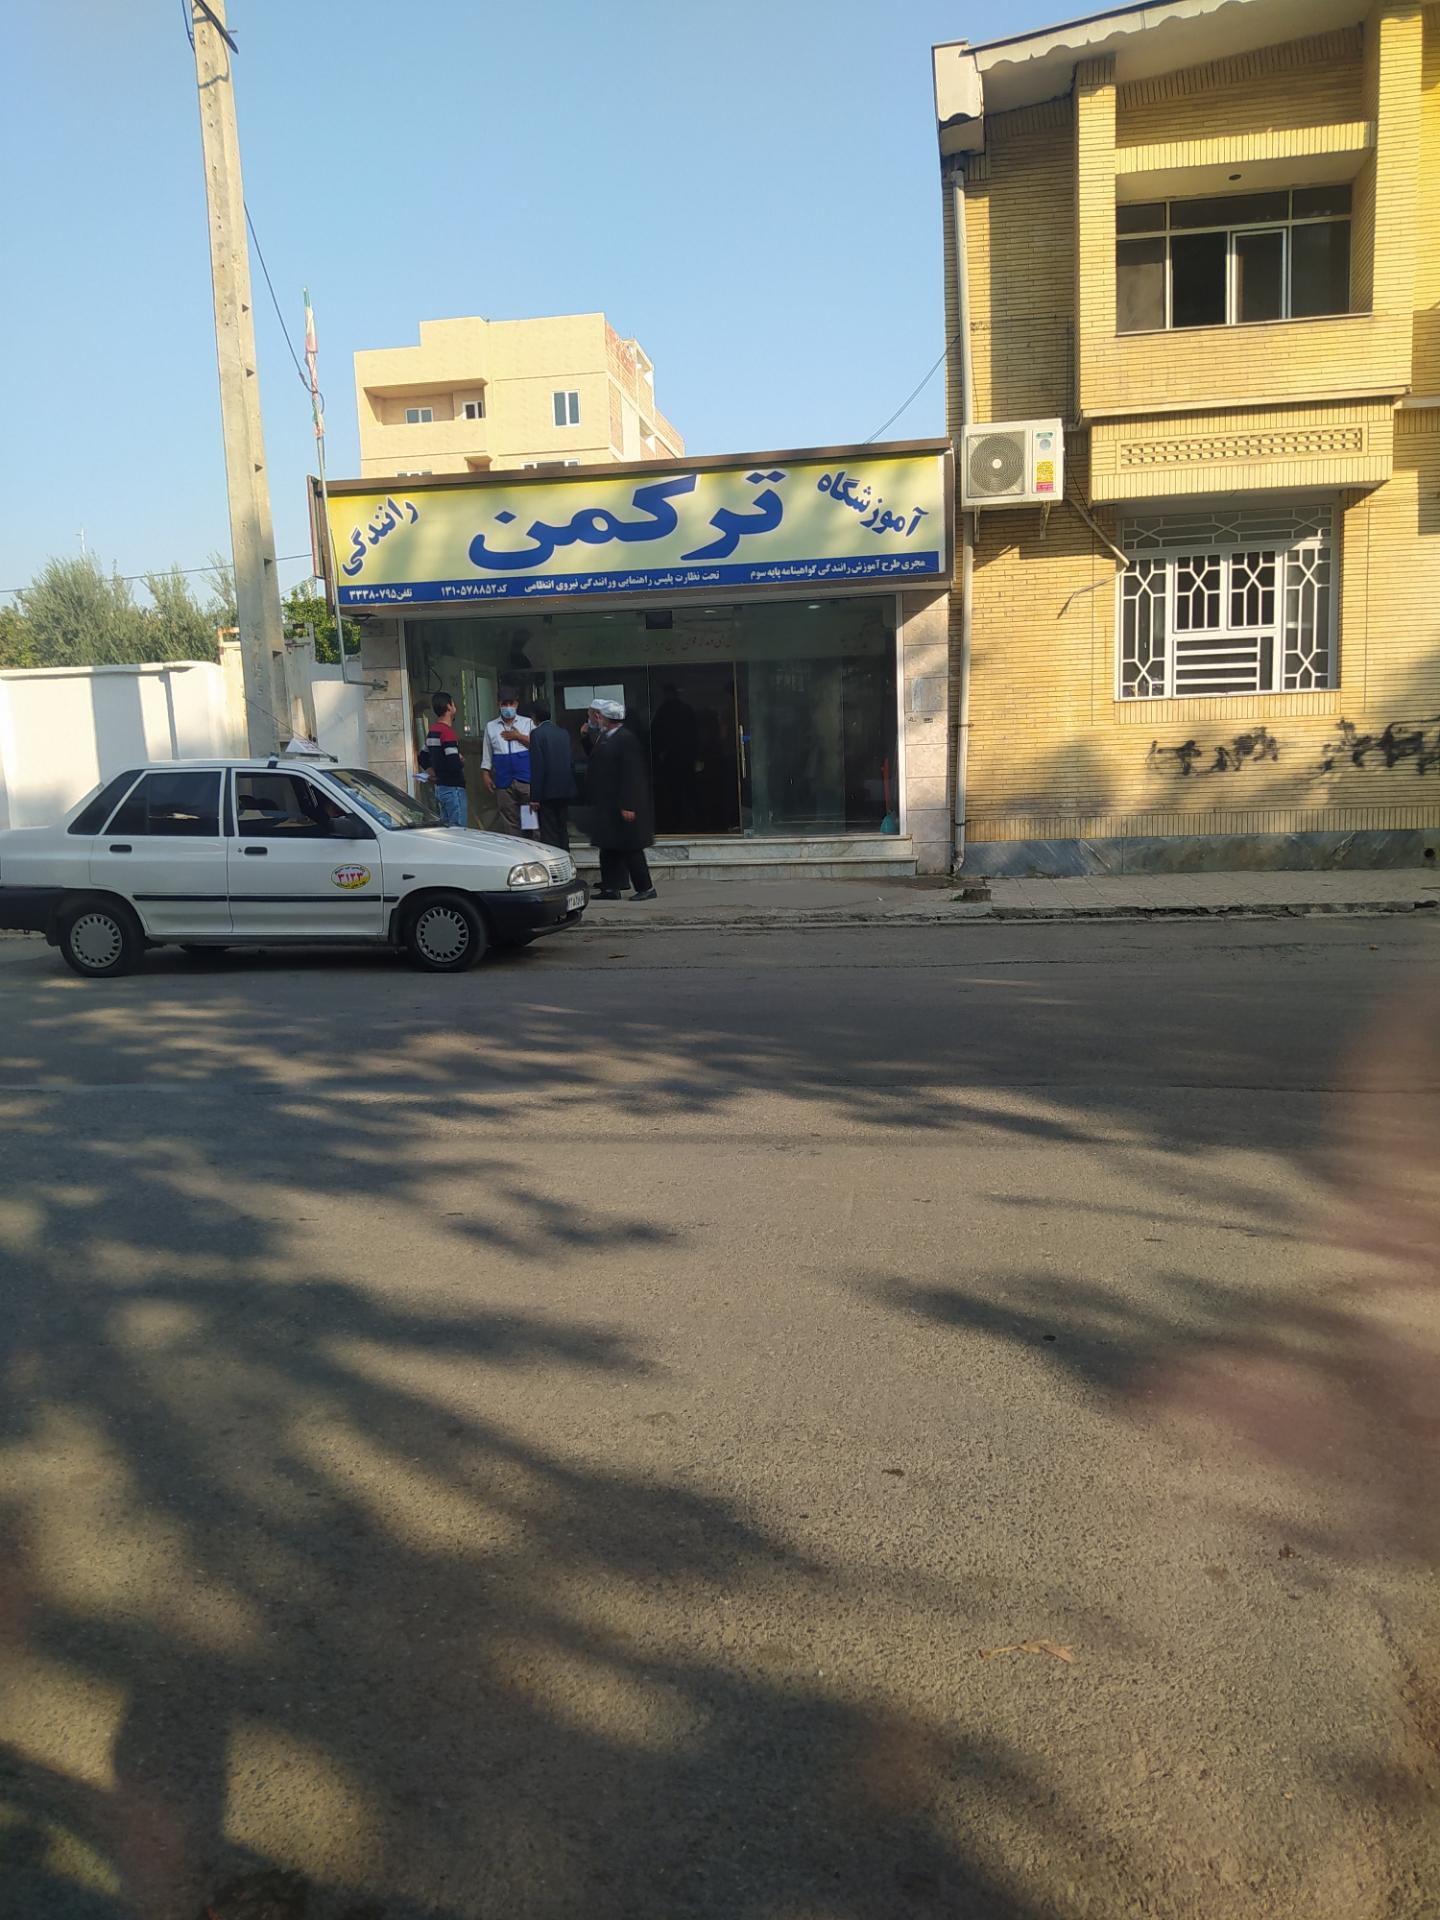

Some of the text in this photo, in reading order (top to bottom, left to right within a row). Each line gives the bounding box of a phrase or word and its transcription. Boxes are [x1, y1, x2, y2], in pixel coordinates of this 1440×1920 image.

[342, 470, 929, 576] آموزشگاه ترکمن رانندگی
[702, 570, 720, 581] تحت
[750, 559, 926, 580] مجری طرح آموزش رانندگی گواهینامه پایه سوم
[618, 575, 652, 588] راهنمایی
[654, 573, 674, 585] پلیس
[675, 571, 700, 584] نظارت
[524, 580, 554, 592] انتظامی
[555, 579, 579, 591] نیروی
